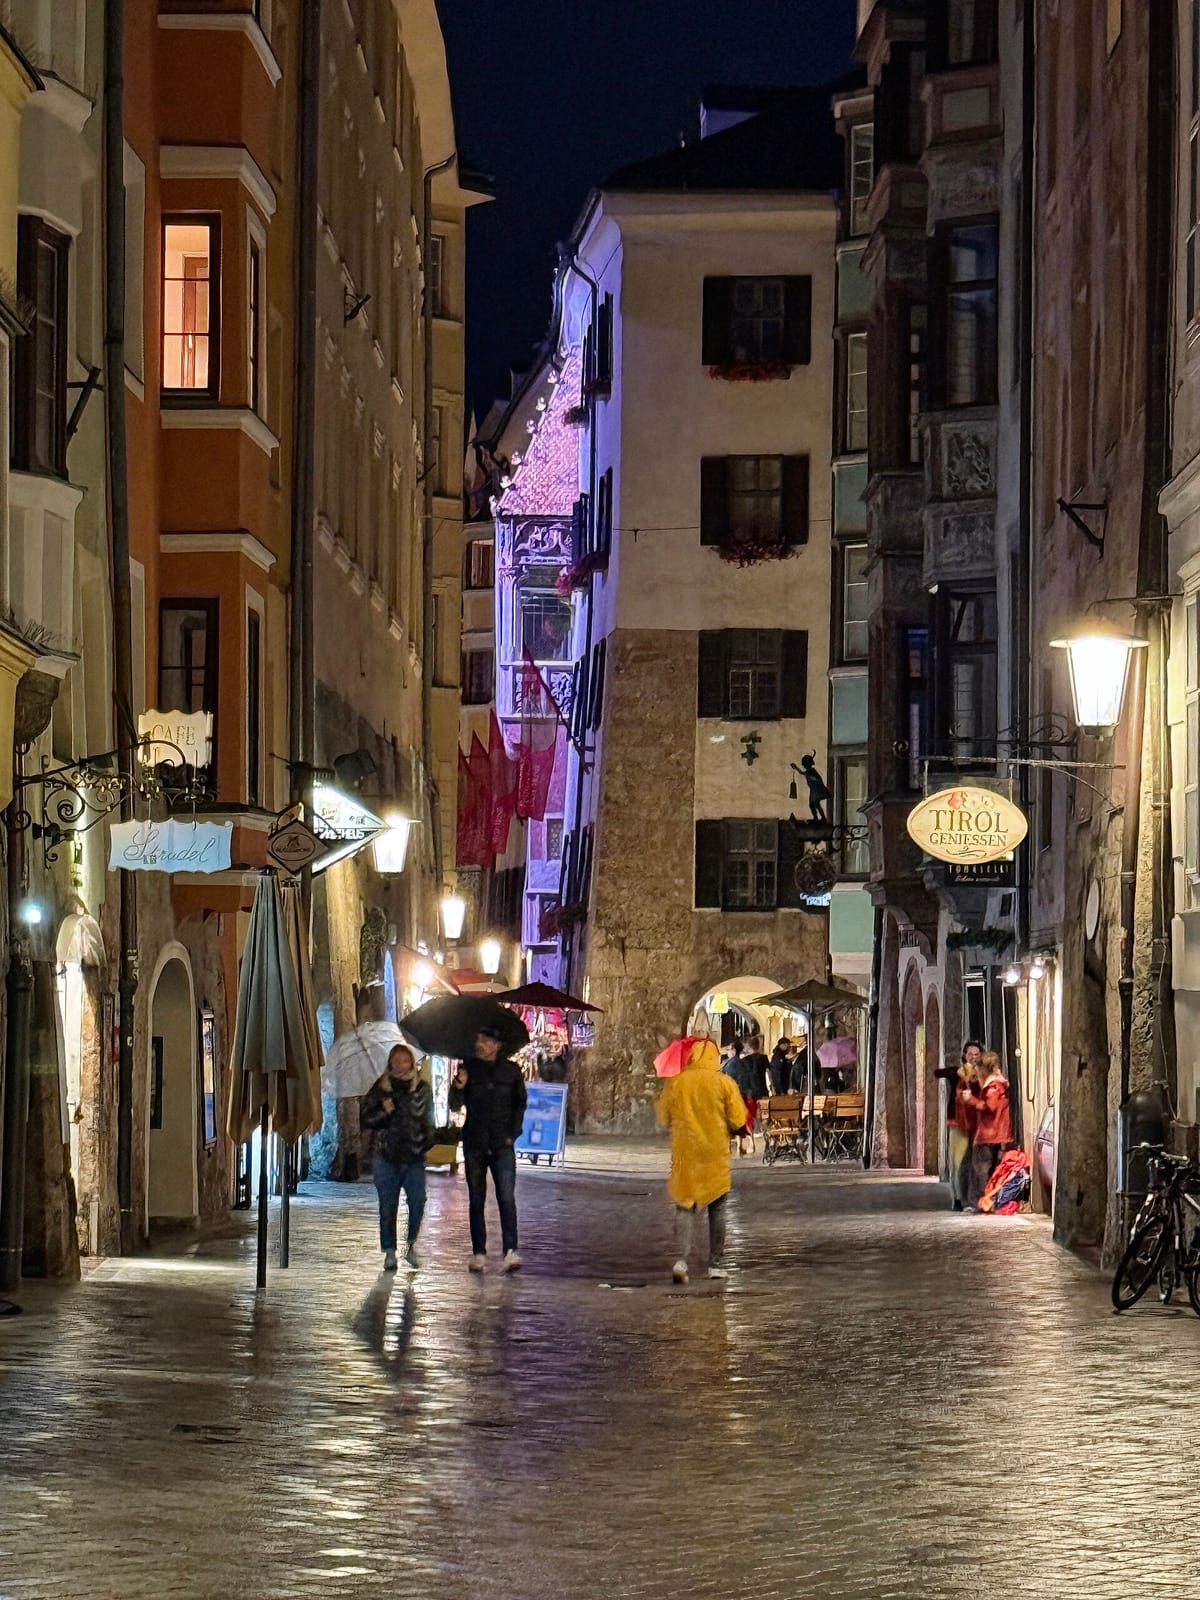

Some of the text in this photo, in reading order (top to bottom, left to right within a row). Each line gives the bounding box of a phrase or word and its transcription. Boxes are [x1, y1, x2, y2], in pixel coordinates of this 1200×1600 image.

[929, 809, 1009, 833] TIROL
[122, 829, 216, 863] Strudel
[929, 832, 1007, 847] GENIESSEN
